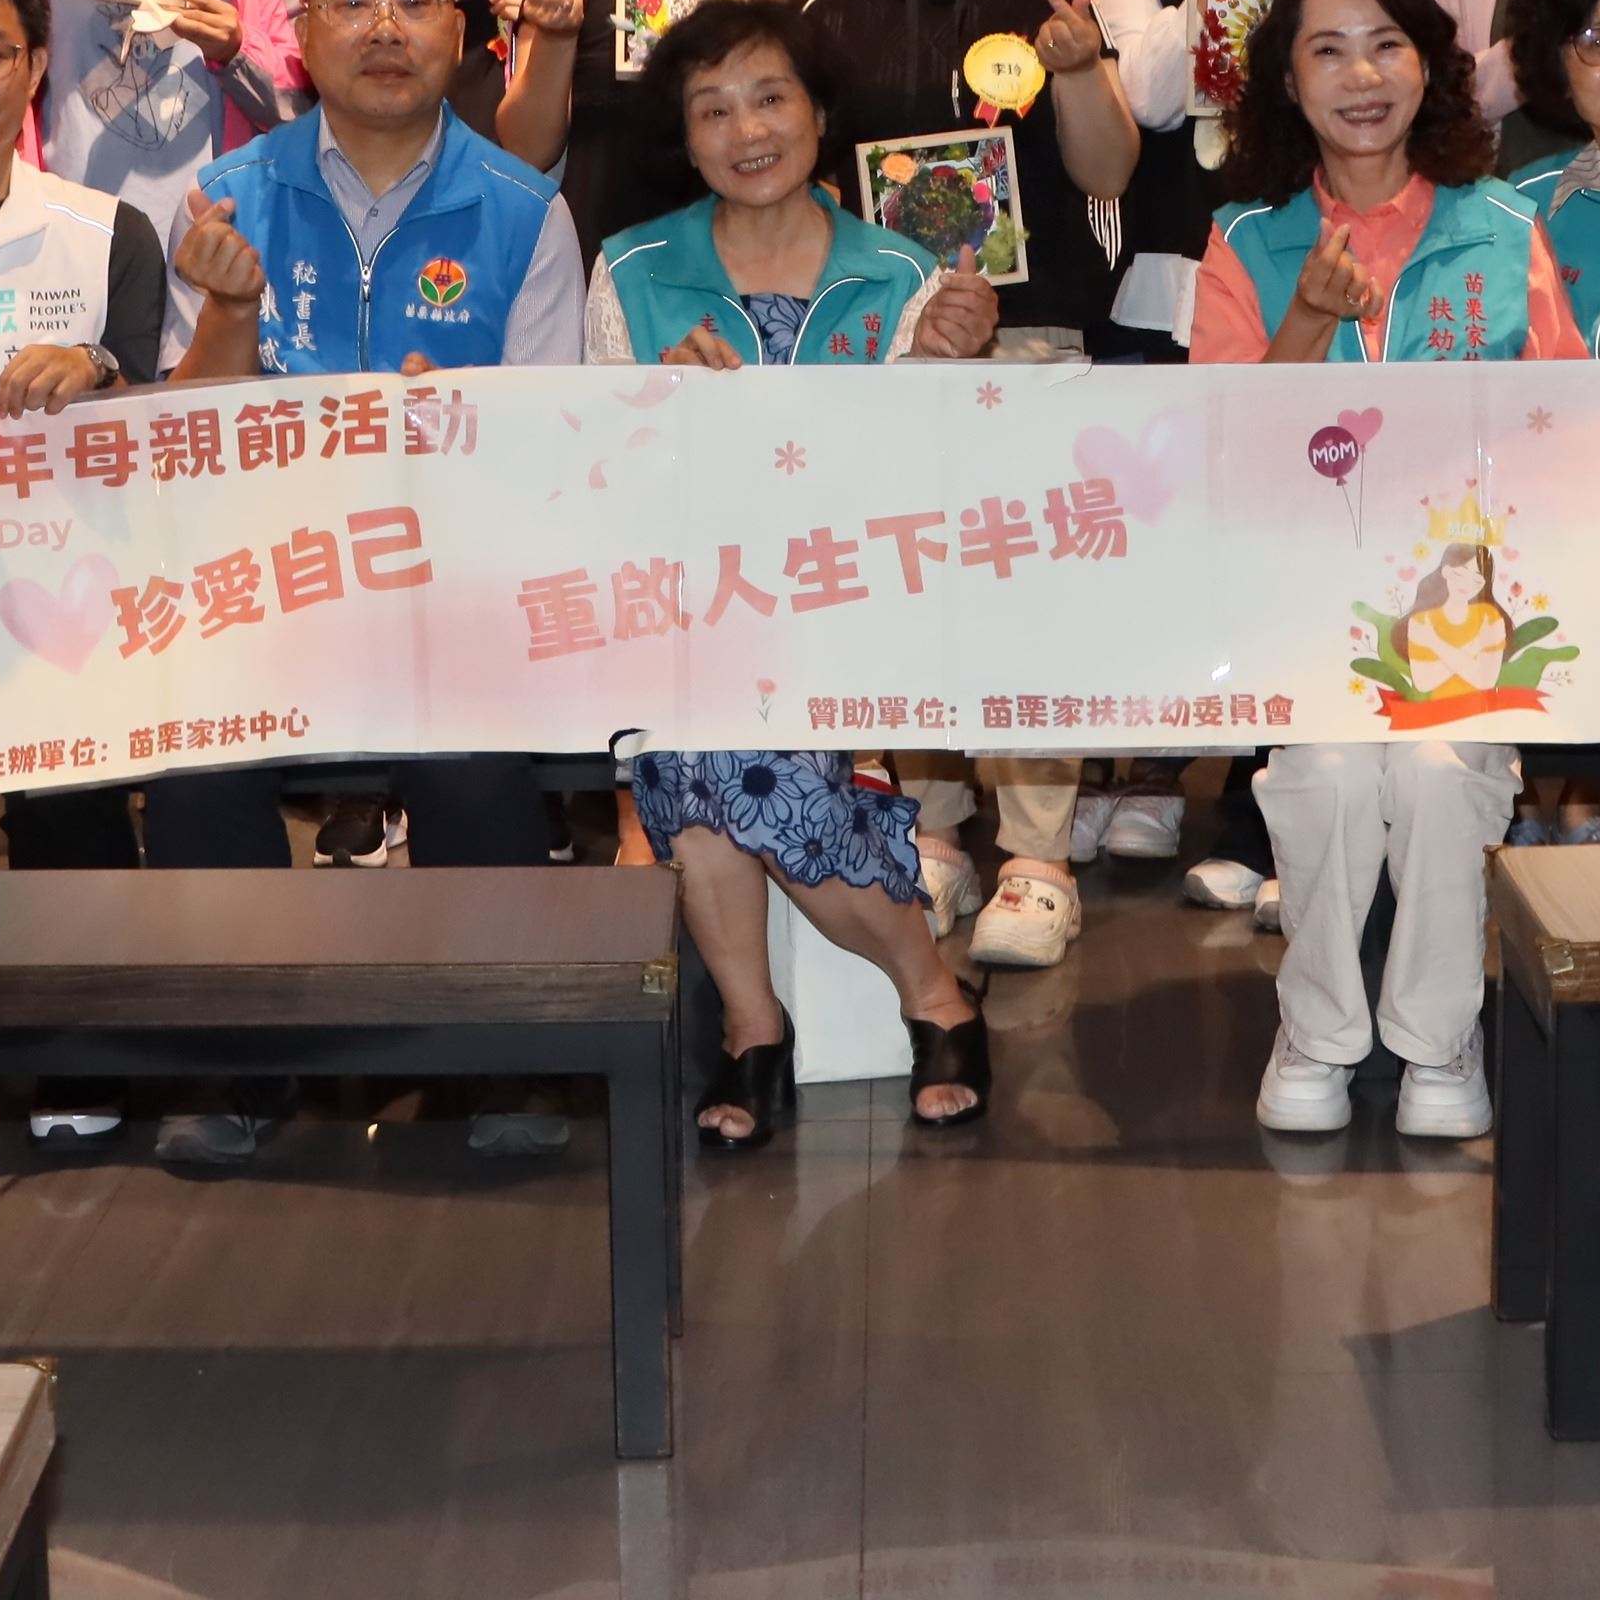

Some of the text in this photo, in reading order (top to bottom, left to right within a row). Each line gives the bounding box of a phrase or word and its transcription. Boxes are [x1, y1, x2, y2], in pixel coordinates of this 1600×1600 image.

[29, 288, 81, 301] TAIWAN
[292, 260, 317, 351] 秘書長
[29, 302, 87, 316] PEOPLE'S
[29, 319, 70, 331] PARTY
[1428, 295, 1456, 361] 扶幼
[829, 332, 855, 357] 扶
[1312, 440, 1357, 466] MOM
[109, 477, 1129, 662] 珍愛自己 重啟人生下半場
